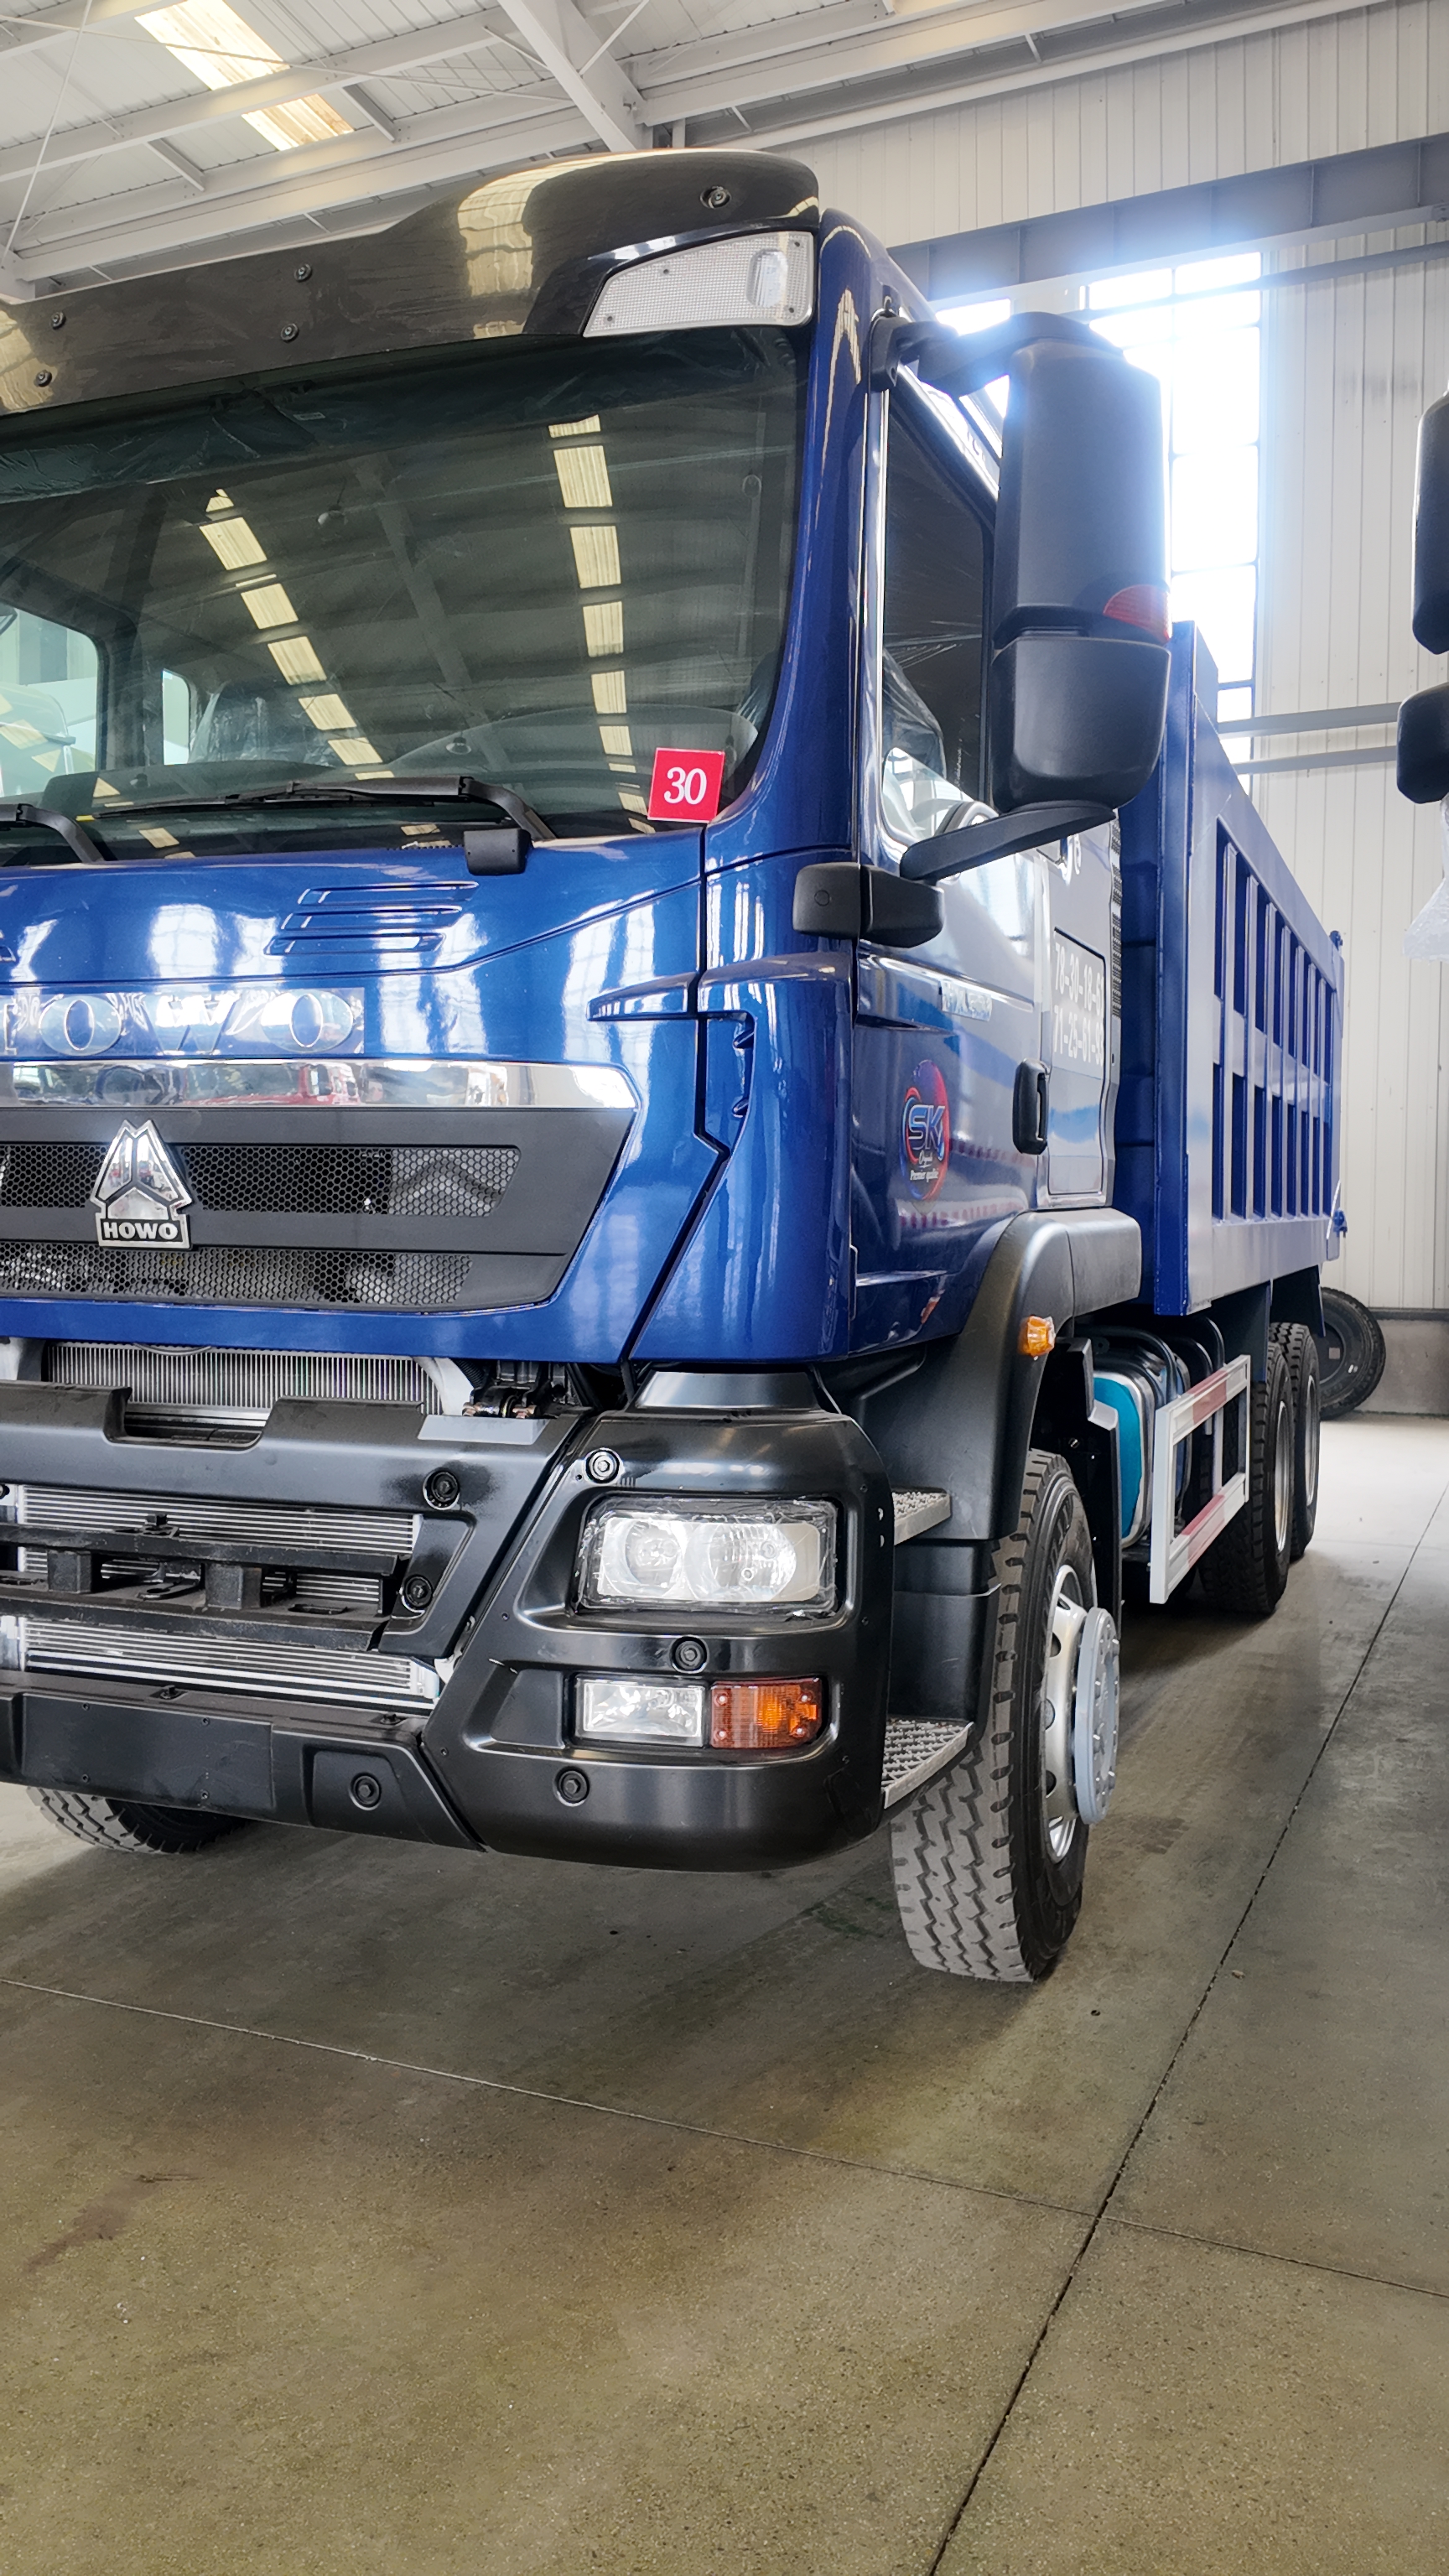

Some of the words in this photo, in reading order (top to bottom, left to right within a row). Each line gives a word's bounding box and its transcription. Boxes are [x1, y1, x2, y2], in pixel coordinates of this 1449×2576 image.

[663, 766, 708, 805] 30
[1054, 942, 1105, 1019] 78-30-18-61
[0, 988, 354, 1056] OWO
[908, 1104, 946, 1150] SK
[102, 1221, 179, 1240] HOWO
